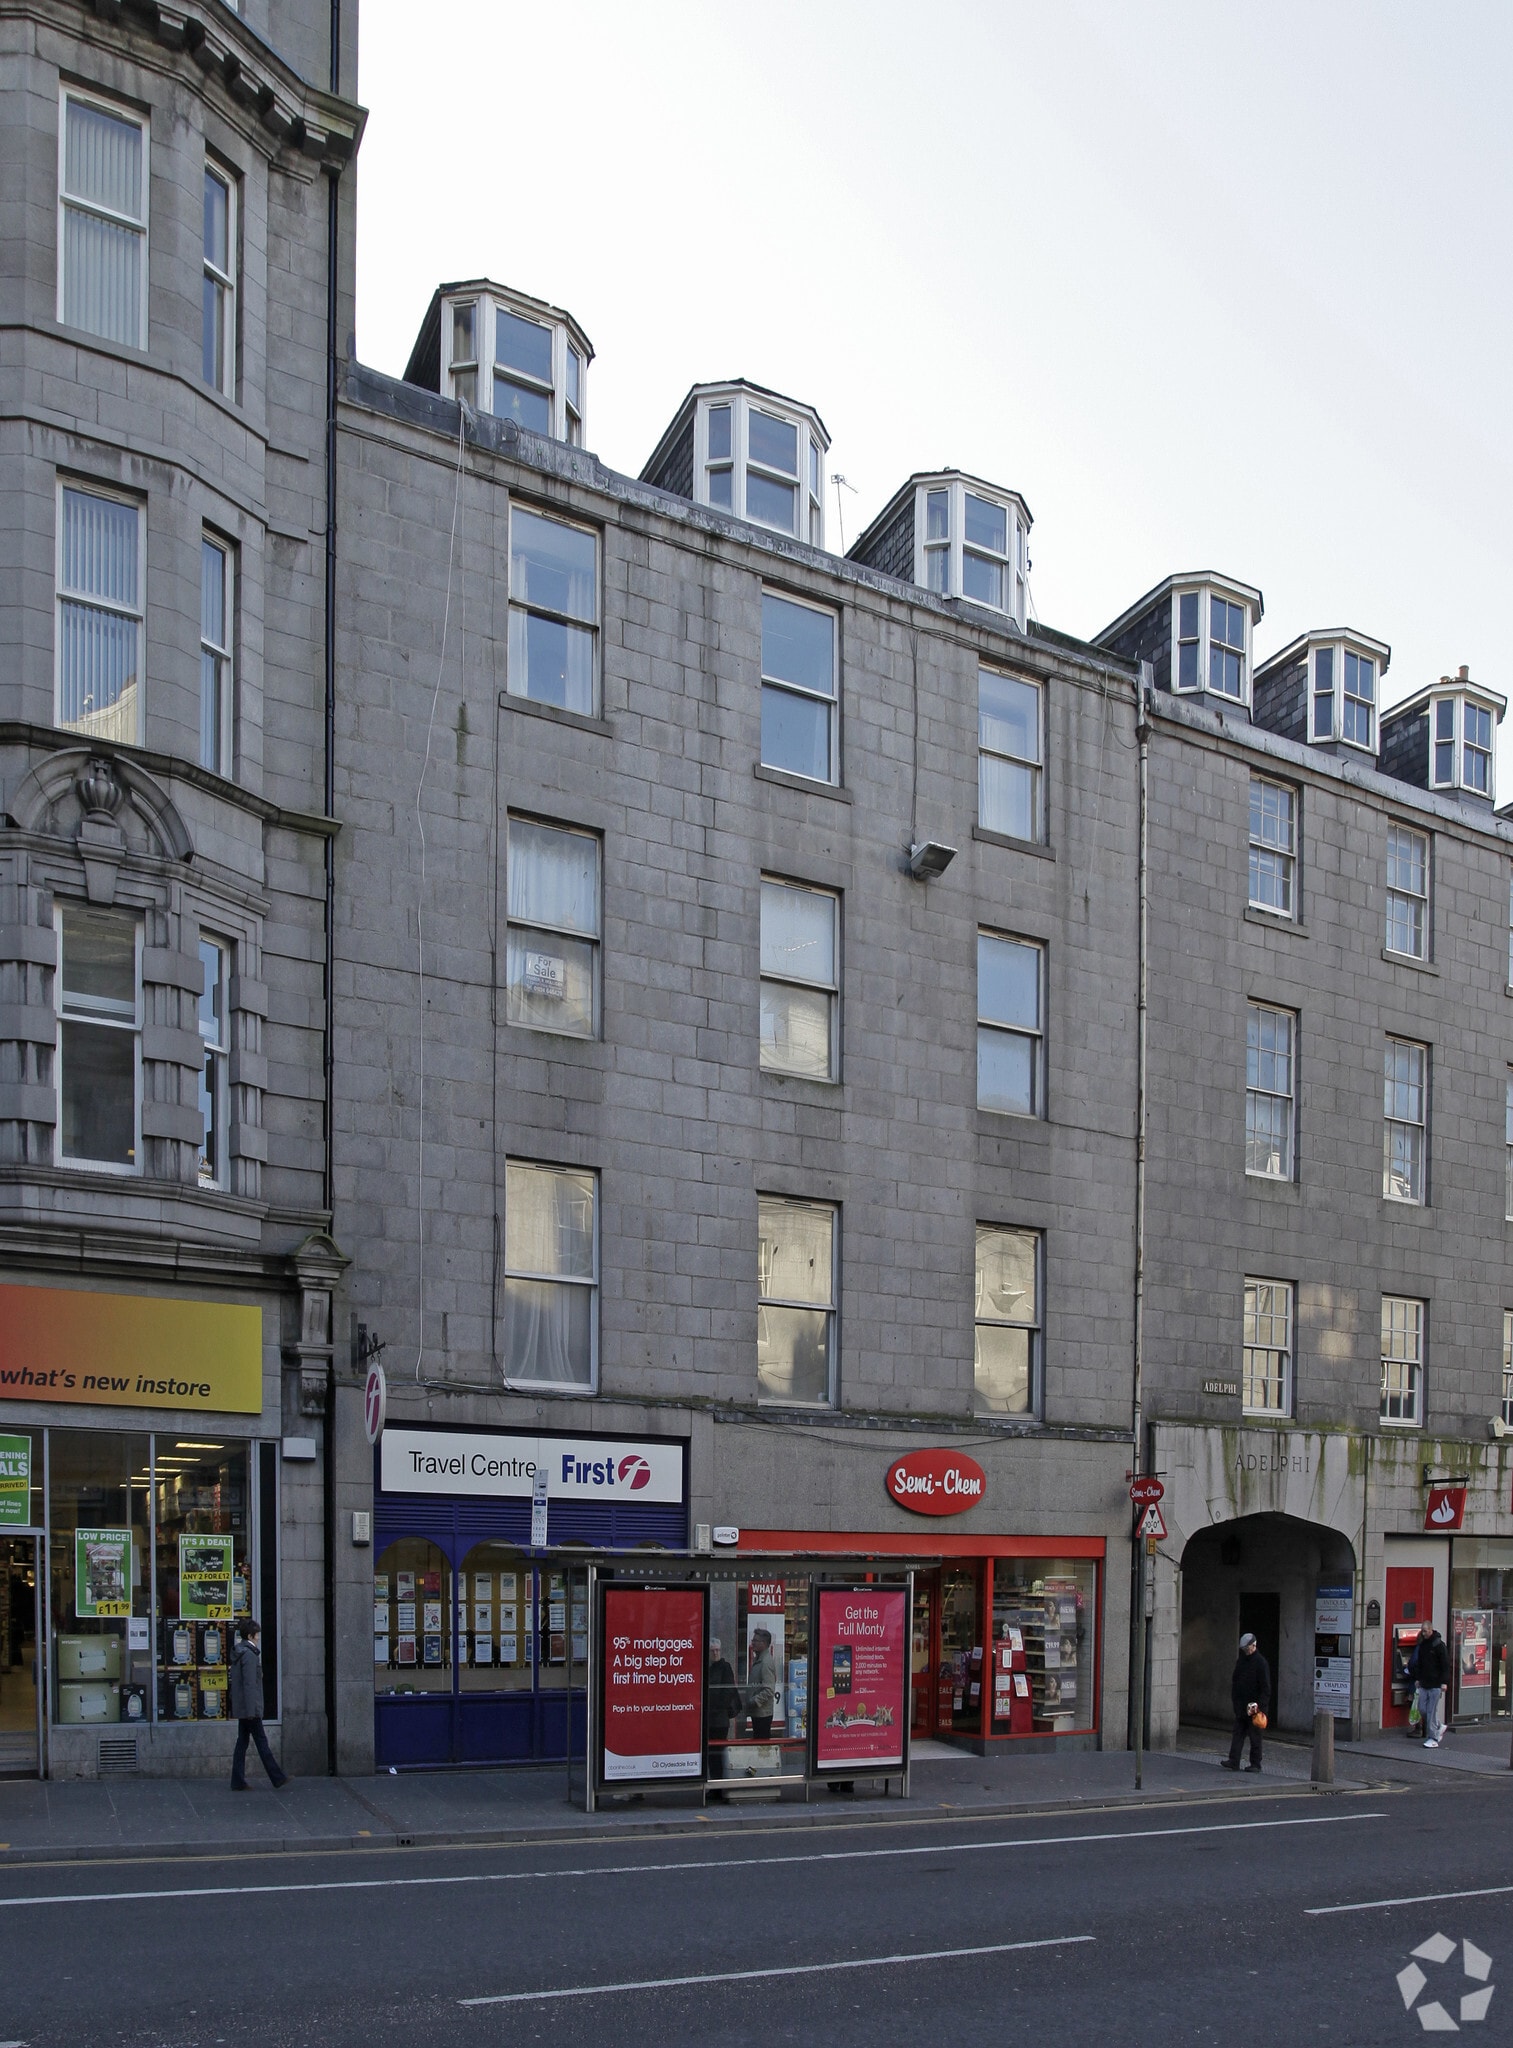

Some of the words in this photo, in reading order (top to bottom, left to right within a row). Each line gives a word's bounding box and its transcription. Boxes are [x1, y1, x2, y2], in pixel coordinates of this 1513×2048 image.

[538, 957, 552, 966] For
[534, 964, 556, 978] Sale
[0, 1367, 76, 1388] what's
[82, 1375, 130, 1392] new
[136, 1375, 210, 1397] instore
[1204, 1382, 1237, 1394] ADELPHI
[408, 1450, 465, 1474] Travel
[471, 1454, 537, 1478] Centre
[562, 1454, 614, 1485] First
[1235, 1454, 1310, 1473] ADELPHI
[894, 1467, 981, 1495] Semi-Chem
[1148, 1540, 1155, 1553] H
[752, 1584, 774, 1594] WHAT
[776, 1585, 782, 1594] A
[752, 1595, 782, 1606] DEAL!
[845, 1606, 862, 1619] Get
[864, 1607, 878, 1619] the
[838, 1622, 854, 1635] Full
[856, 1622, 885, 1638] Monty
[613, 1636, 630, 1649] 95%
[634, 1637, 694, 1652] mortgages.
[613, 1655, 621, 1666] A
[624, 1655, 642, 1669] big
[645, 1655, 667, 1668] step
[670, 1654, 683, 1666] for
[613, 1672, 630, 1684] first
[633, 1672, 656, 1684] time
[659, 1672, 695, 1686] buyers.
[613, 1705, 625, 1714] Pop
[641, 1705, 655, 1713] your
